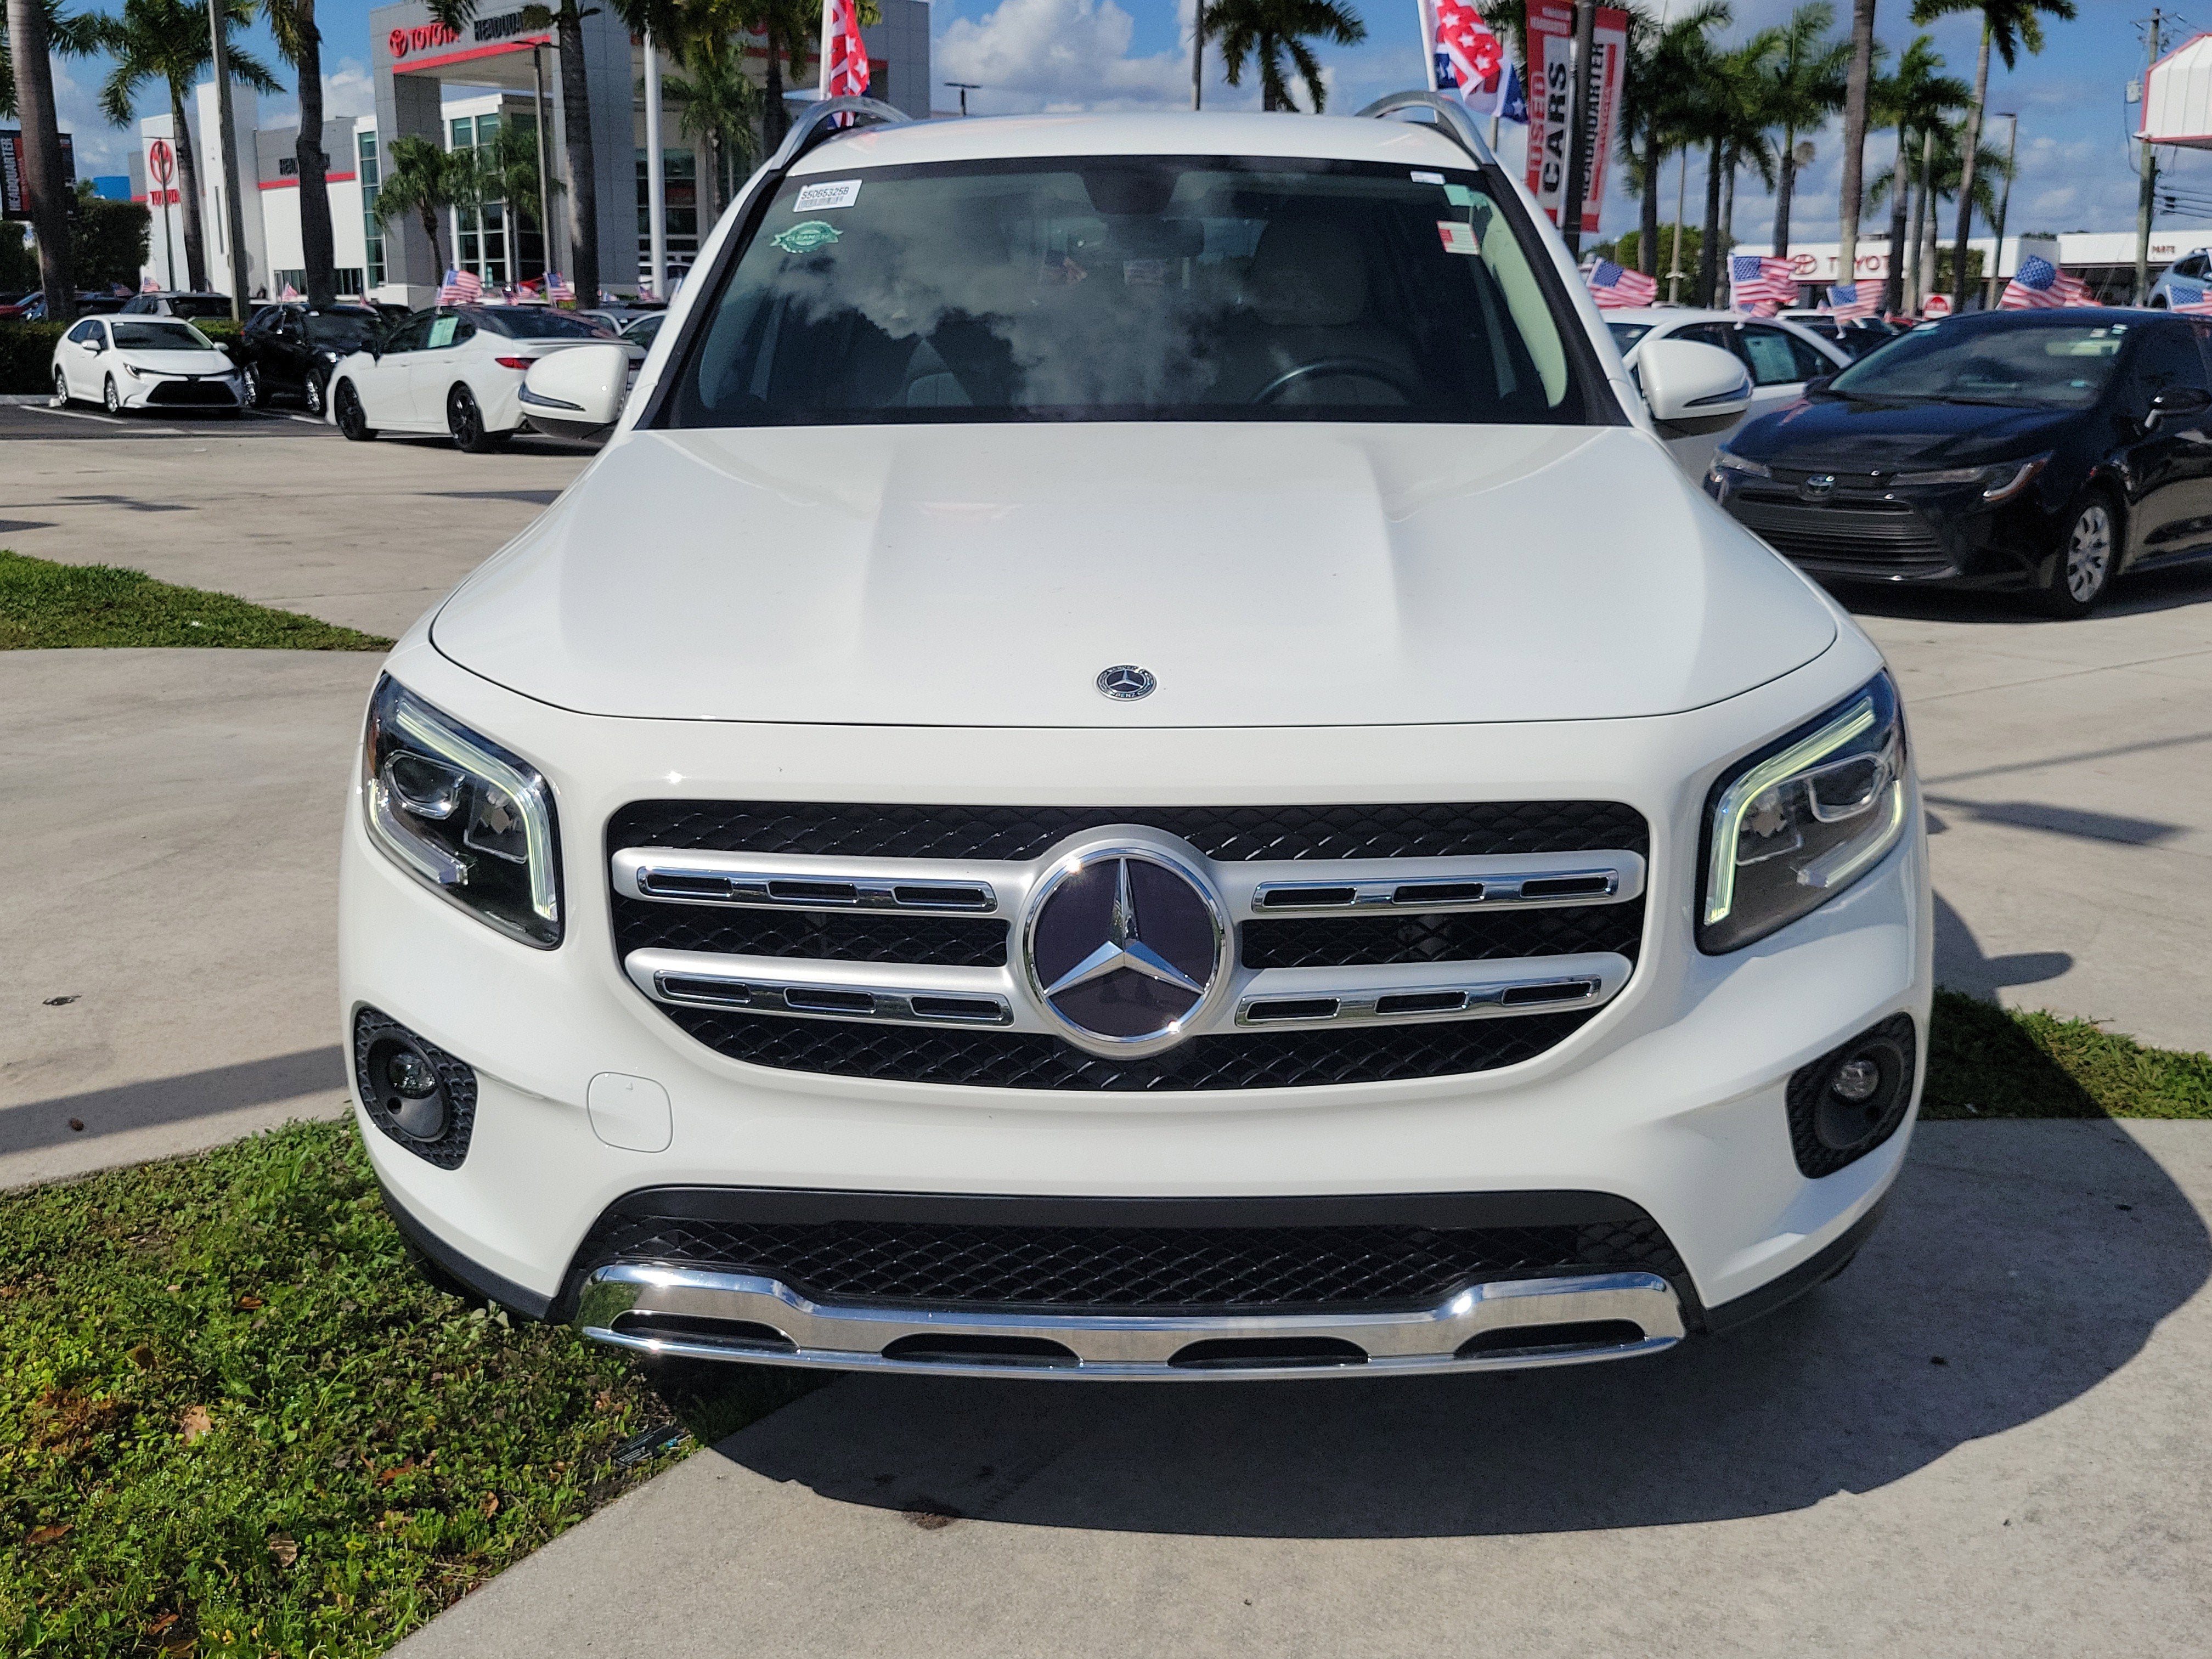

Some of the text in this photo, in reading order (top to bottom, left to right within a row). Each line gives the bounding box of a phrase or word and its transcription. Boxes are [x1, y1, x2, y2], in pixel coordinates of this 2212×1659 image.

[409, 21, 460, 51] TOYOTA
[1529, 72, 1545, 171] USED
[1543, 62, 1566, 192] CARS
[150, 189, 180, 206] TOOTA
[1827, 255, 1891, 273] TYOT
